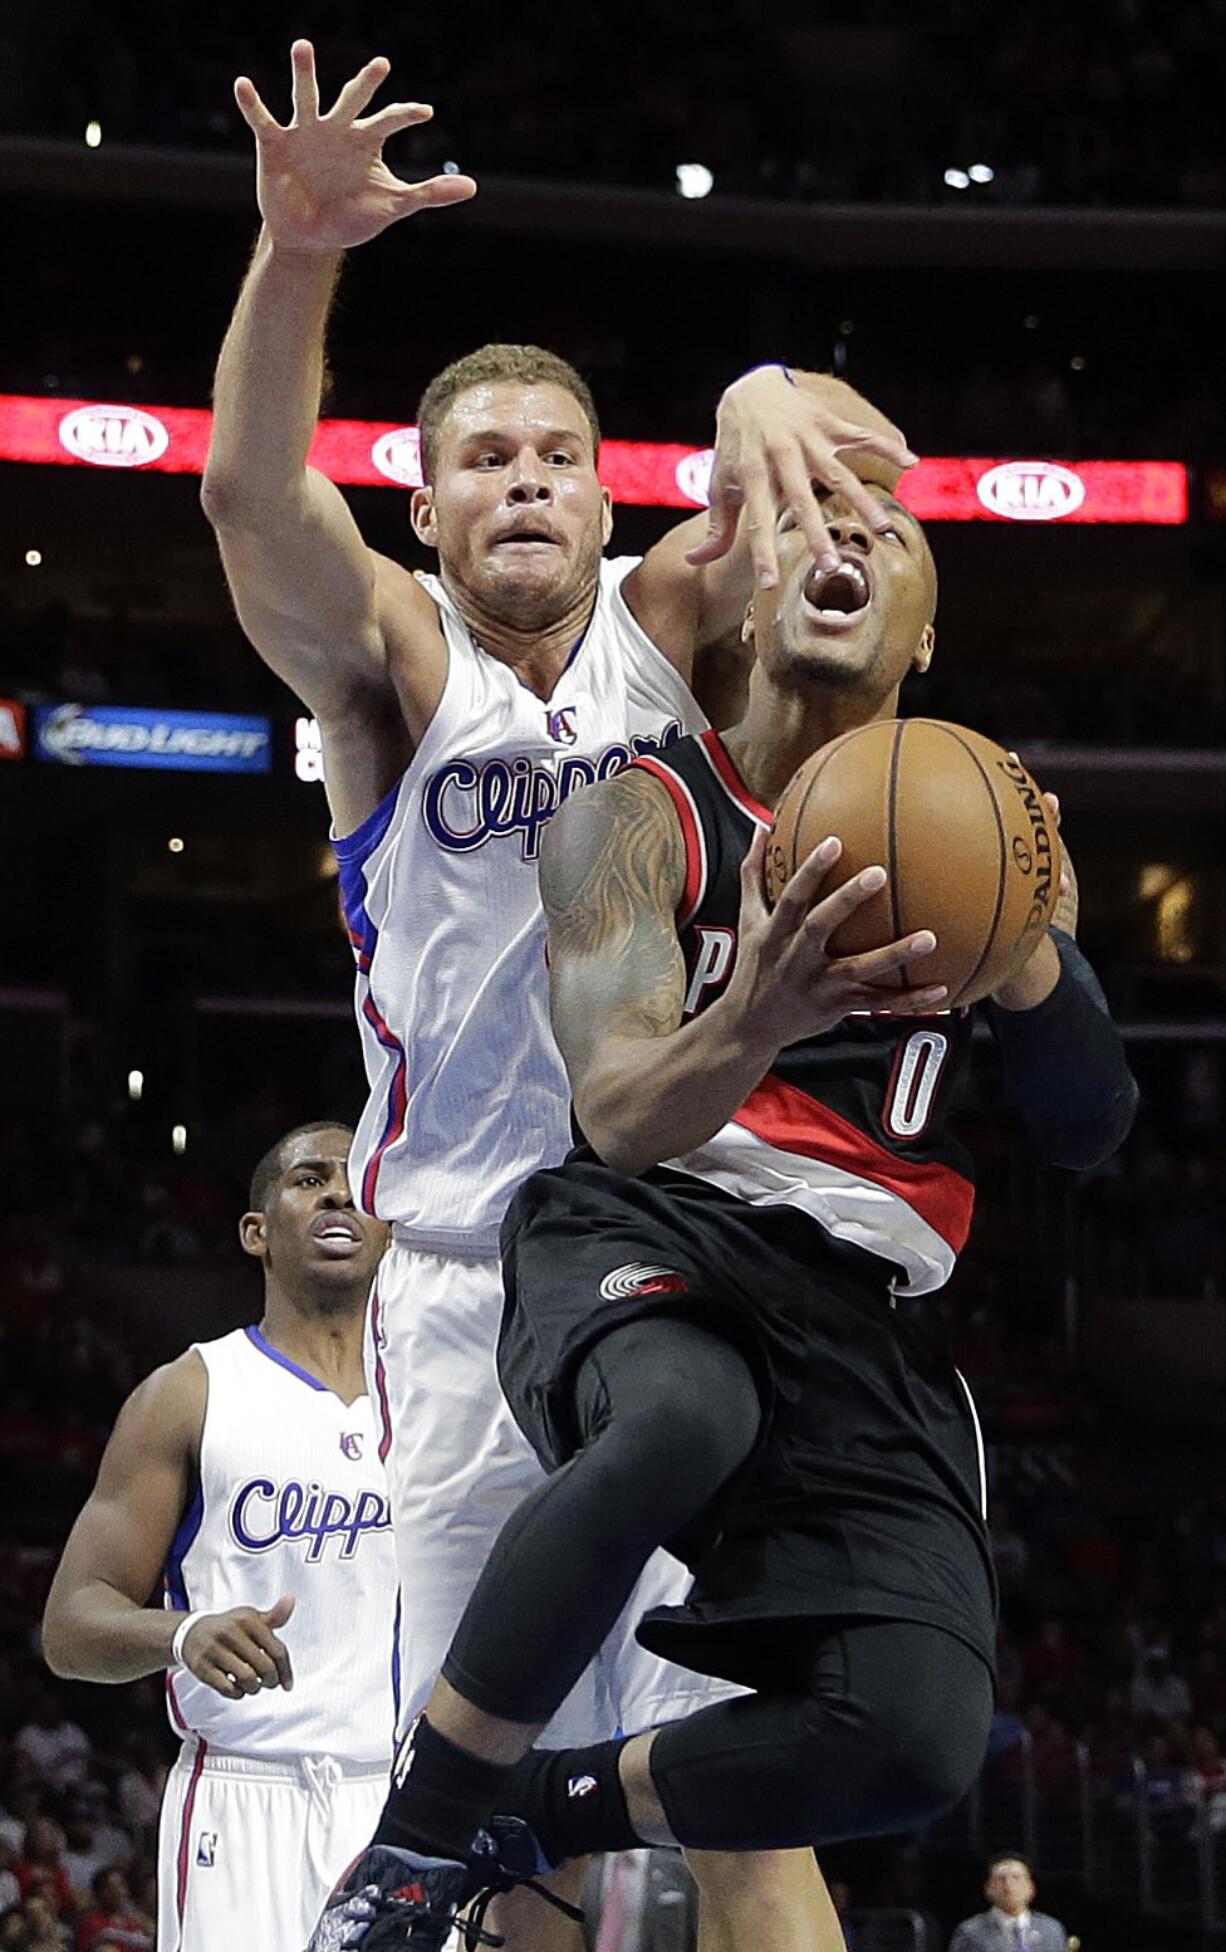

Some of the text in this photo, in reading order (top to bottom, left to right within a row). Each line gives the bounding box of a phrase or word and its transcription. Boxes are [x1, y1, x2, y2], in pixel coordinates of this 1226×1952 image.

[77, 417, 152, 455] KIA
[995, 474, 1068, 508] KIA
[883, 1022, 949, 1140] 0
[228, 1476, 393, 1563] Clipp
